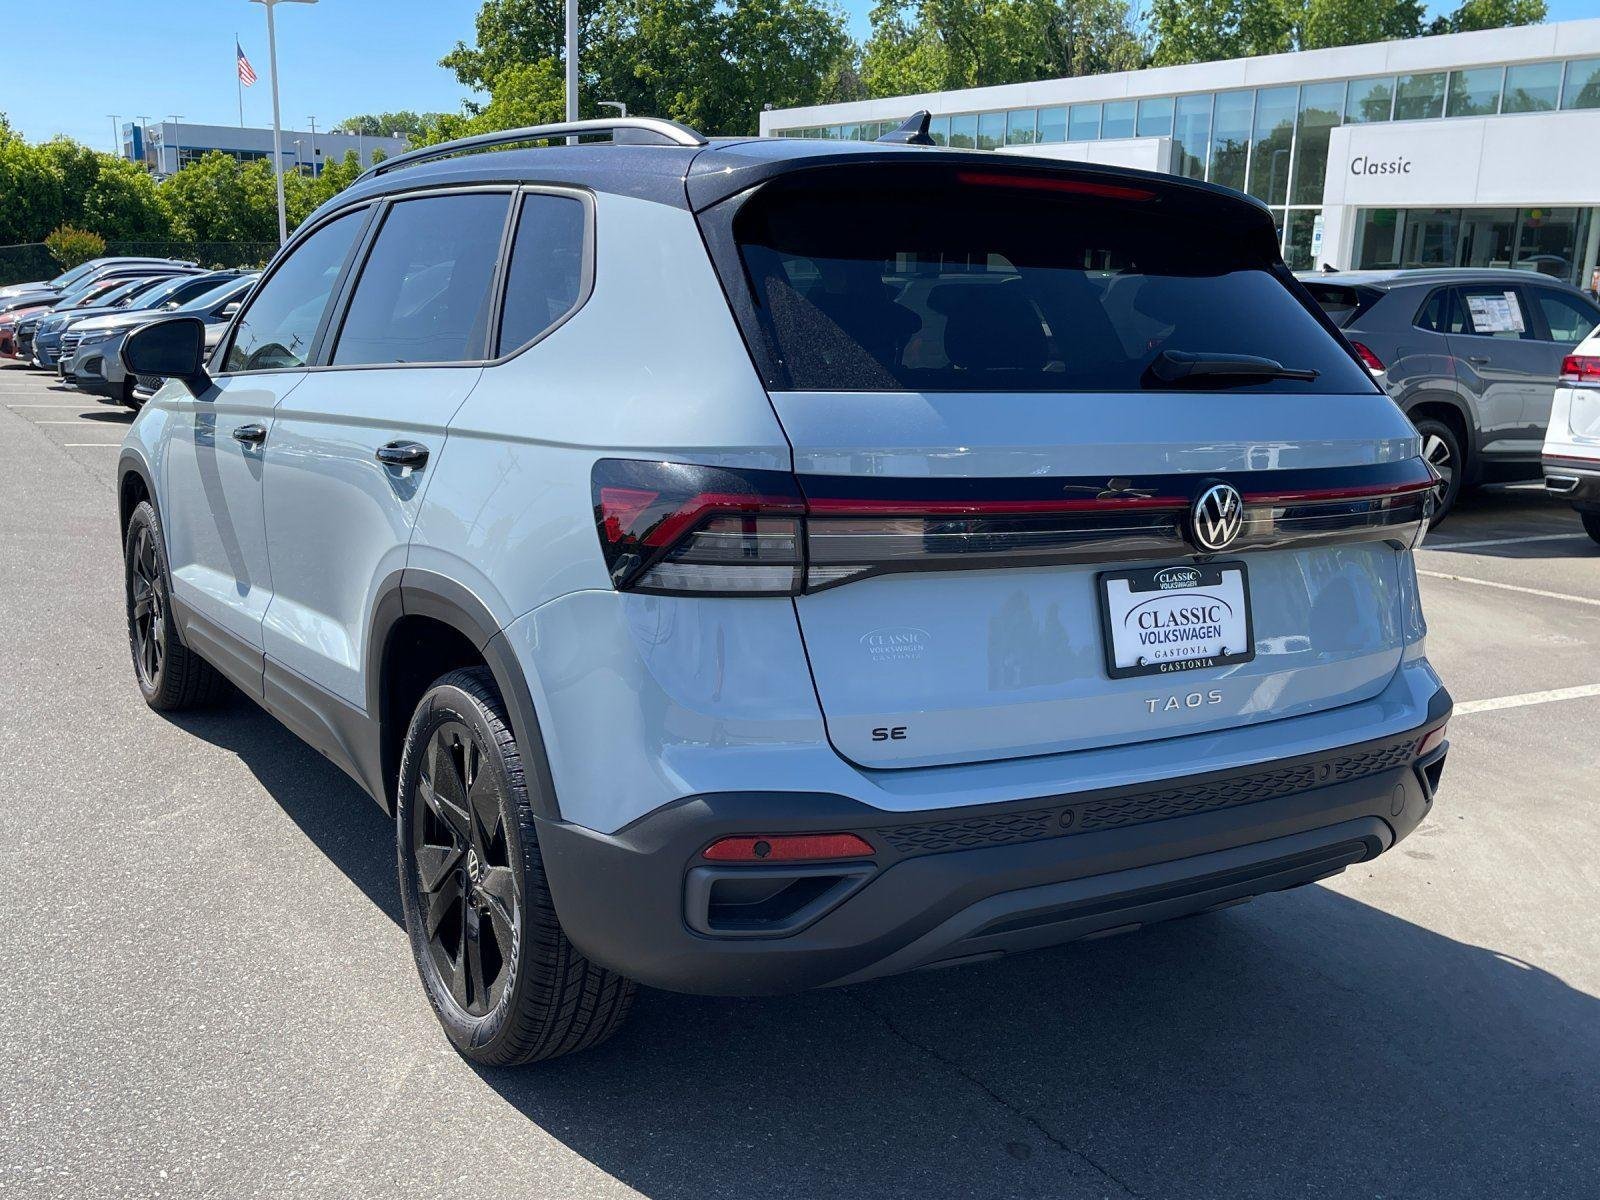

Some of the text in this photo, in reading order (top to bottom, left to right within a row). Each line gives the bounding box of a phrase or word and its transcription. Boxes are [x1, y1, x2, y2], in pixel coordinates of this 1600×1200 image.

[1351, 156, 1411, 175] Classic
[1159, 571, 1197, 582] CLASSIC
[1160, 580, 1198, 590] VOLKSWAGEN
[1138, 605, 1221, 630] CLASSIC
[869, 633, 920, 645] CLASSIC
[1139, 625, 1222, 645] VOLKSWAGEN
[869, 644, 924, 654] VOLKSWAGEN
[1154, 646, 1208, 659] GASTONIA
[1160, 658, 1214, 672] GASTONIA
[1145, 689, 1222, 713] TAOS
[872, 726, 907, 741] SE
